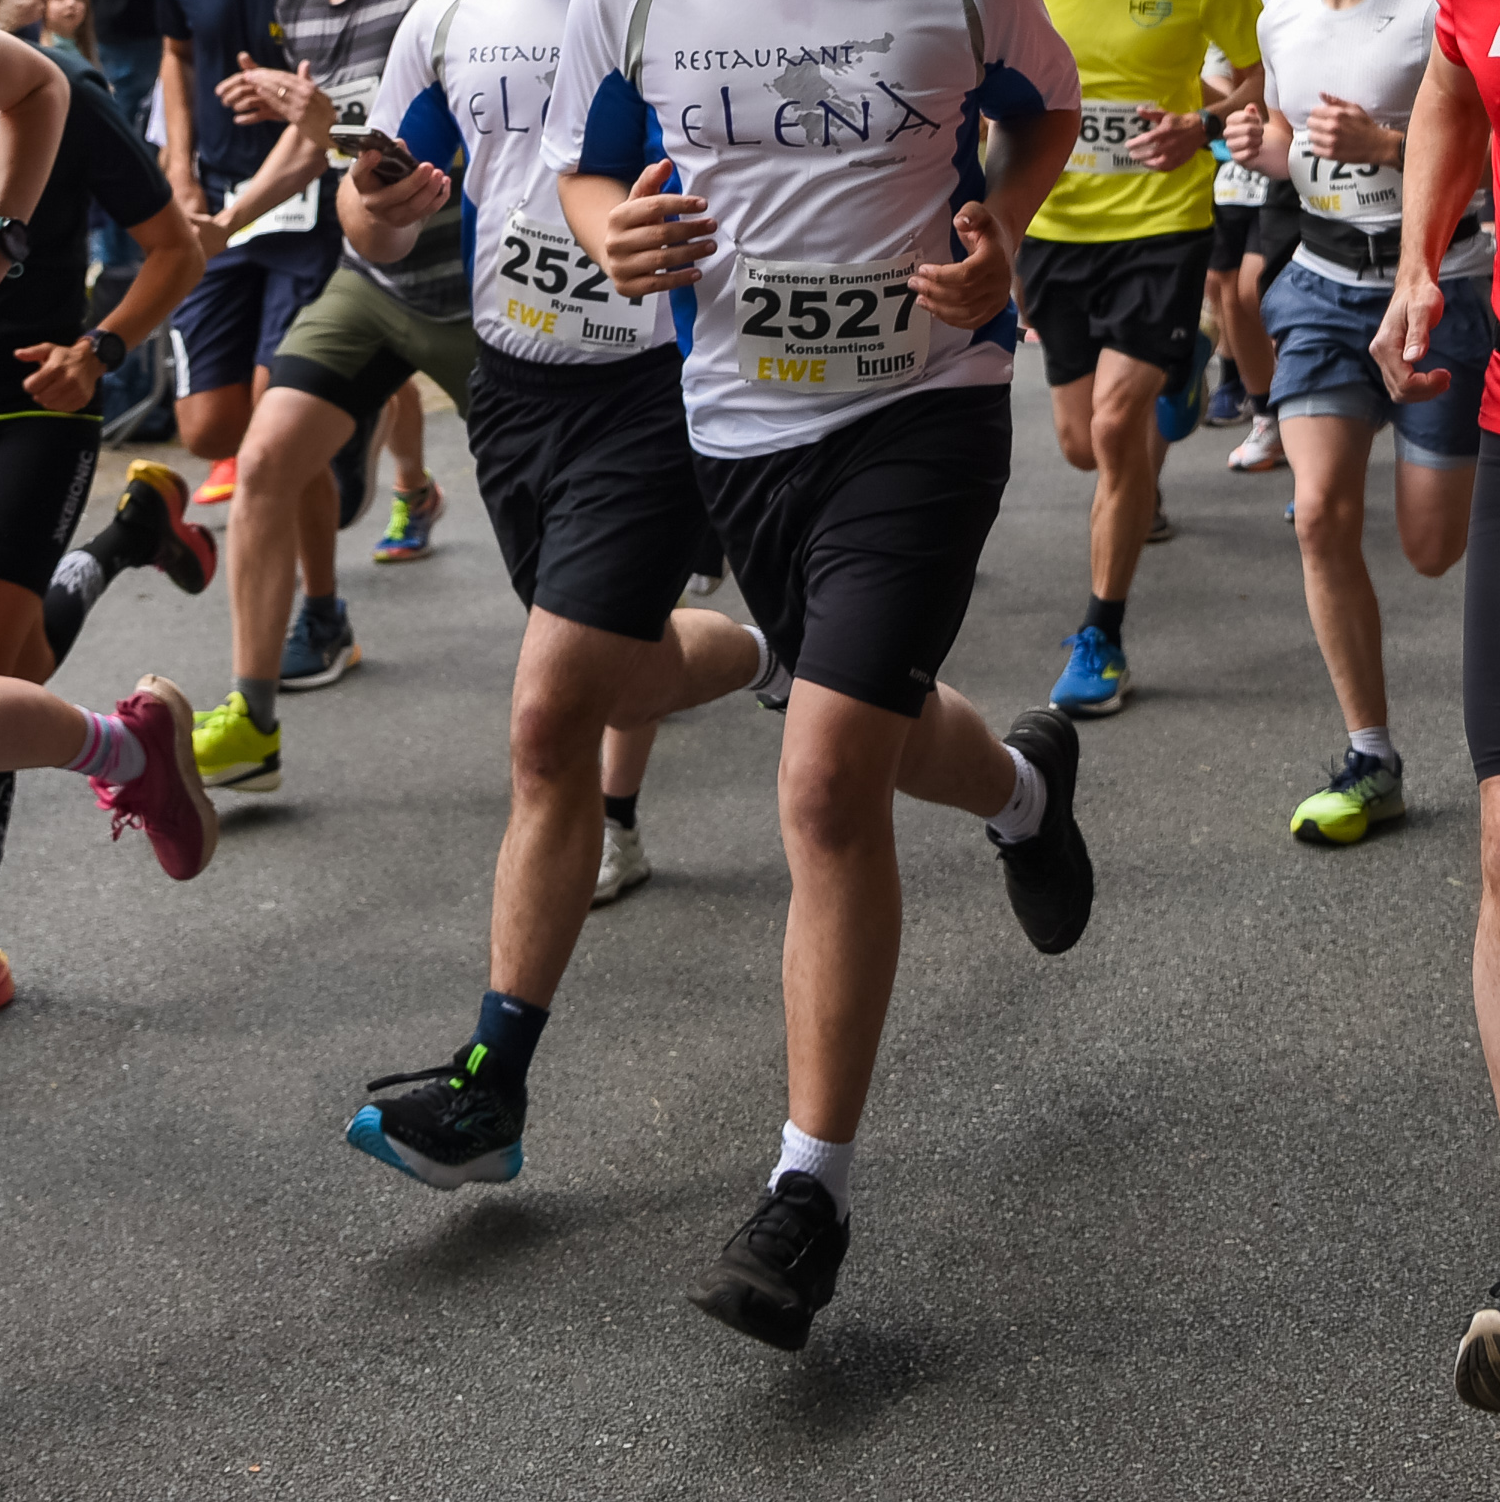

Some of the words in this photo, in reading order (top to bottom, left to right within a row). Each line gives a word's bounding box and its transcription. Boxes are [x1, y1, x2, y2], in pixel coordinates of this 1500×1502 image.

[468, 45, 560, 64] RESTAUR
[674, 45, 855, 71] RESTAURANT
[681, 80, 942, 149] ELENA
[1070, 153, 1097, 168] WE
[1356, 187, 1397, 206] bruns
[500, 235, 643, 307] 252
[748, 269, 825, 286] Everstener
[829, 262, 916, 285] Brunnenlauf
[507, 298, 558, 334] EWE
[550, 299, 583, 314] Ryan
[741, 282, 918, 341] 2527
[582, 317, 638, 343] bruns
[784, 340, 885, 355] Konstantinos
[757, 356, 828, 383] EWE
[856, 351, 916, 376] bruns
